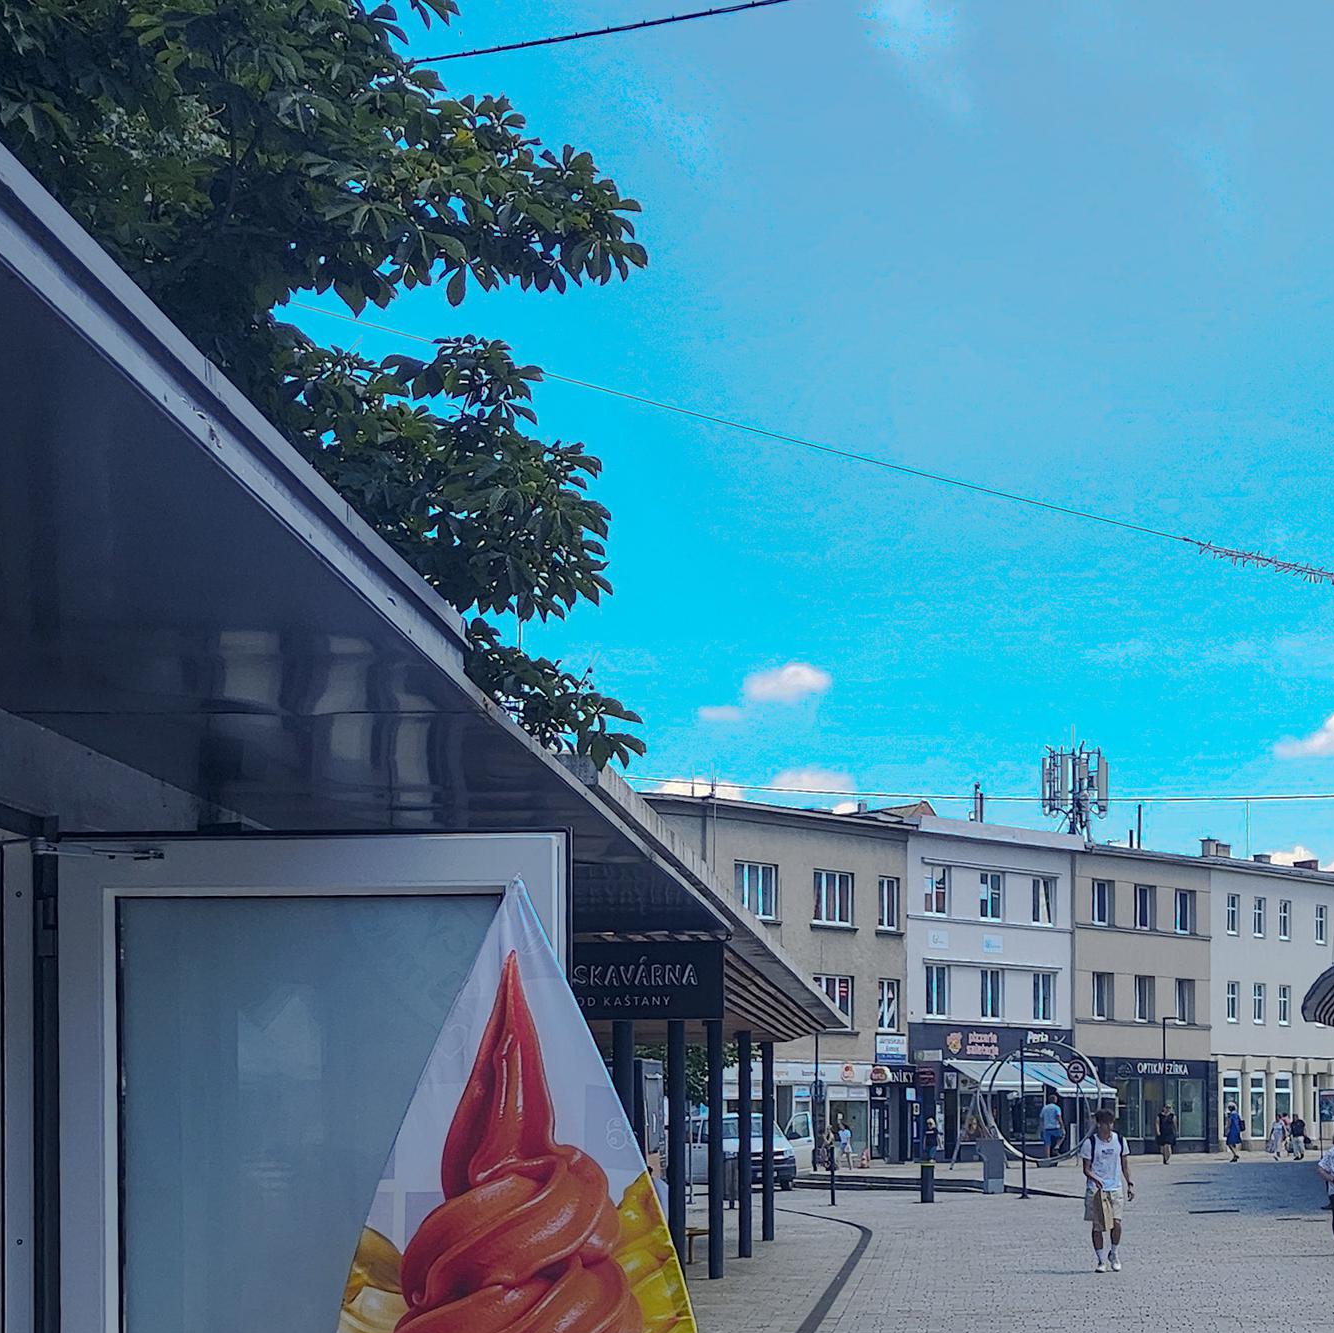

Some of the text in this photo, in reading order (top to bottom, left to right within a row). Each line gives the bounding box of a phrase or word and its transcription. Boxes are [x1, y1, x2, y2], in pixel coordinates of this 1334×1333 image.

[572, 956, 698, 987] SKAVÁRNA
[576, 994, 670, 1007] OD KAŠTANY
